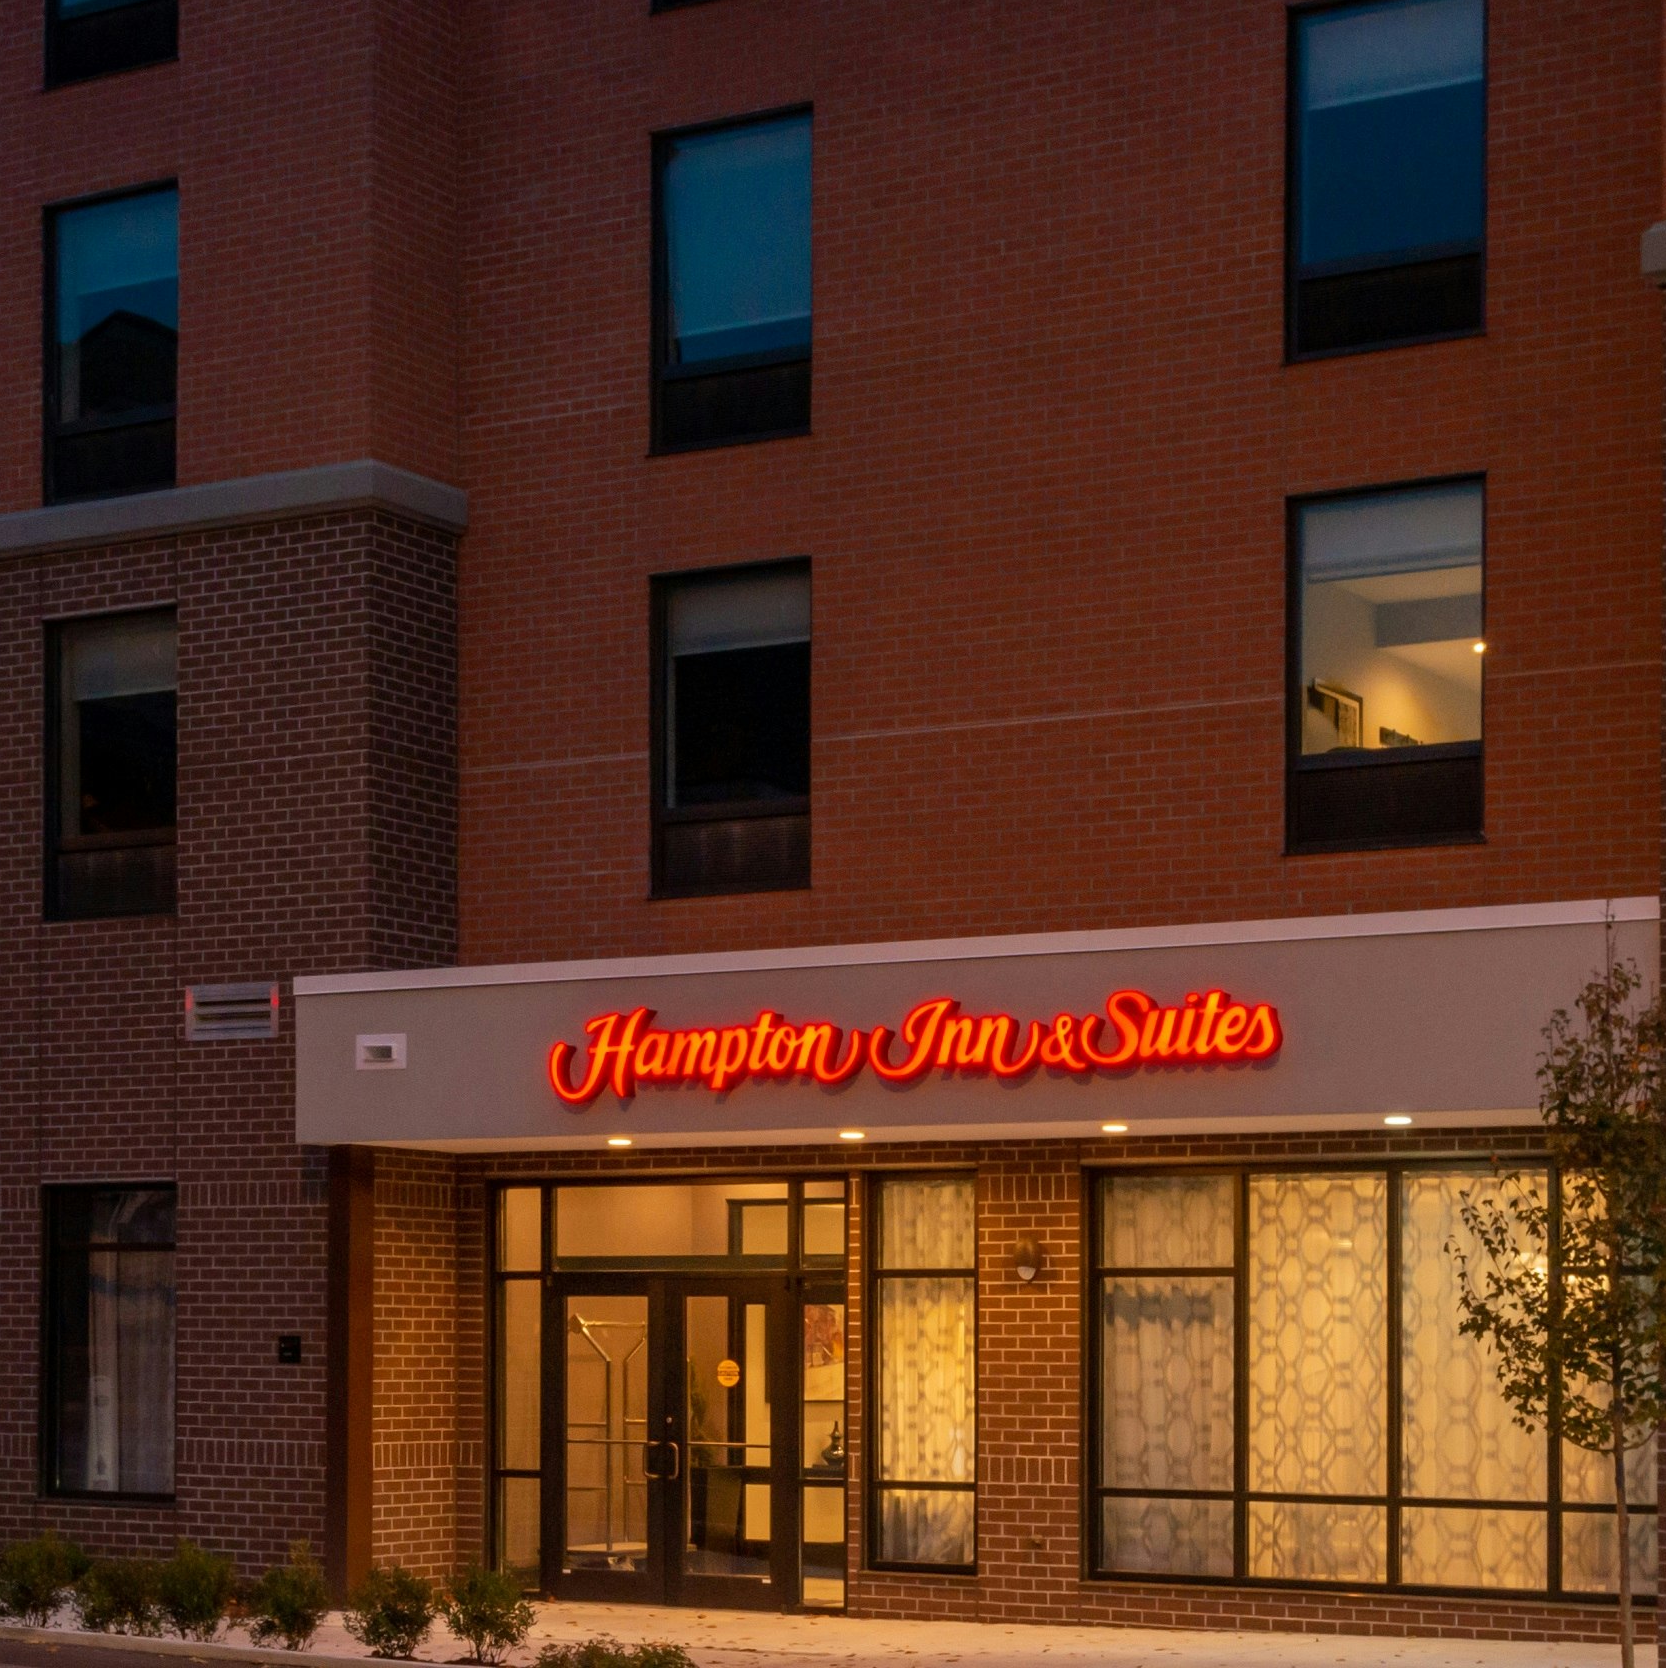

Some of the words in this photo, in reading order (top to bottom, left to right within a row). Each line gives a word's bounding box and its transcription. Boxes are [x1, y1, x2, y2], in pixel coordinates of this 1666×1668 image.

[549, 1005, 863, 1102] Hampton
[868, 997, 1039, 1078] Inn
[1039, 1013, 1086, 1071] &
[1080, 989, 1277, 1066] Suites
